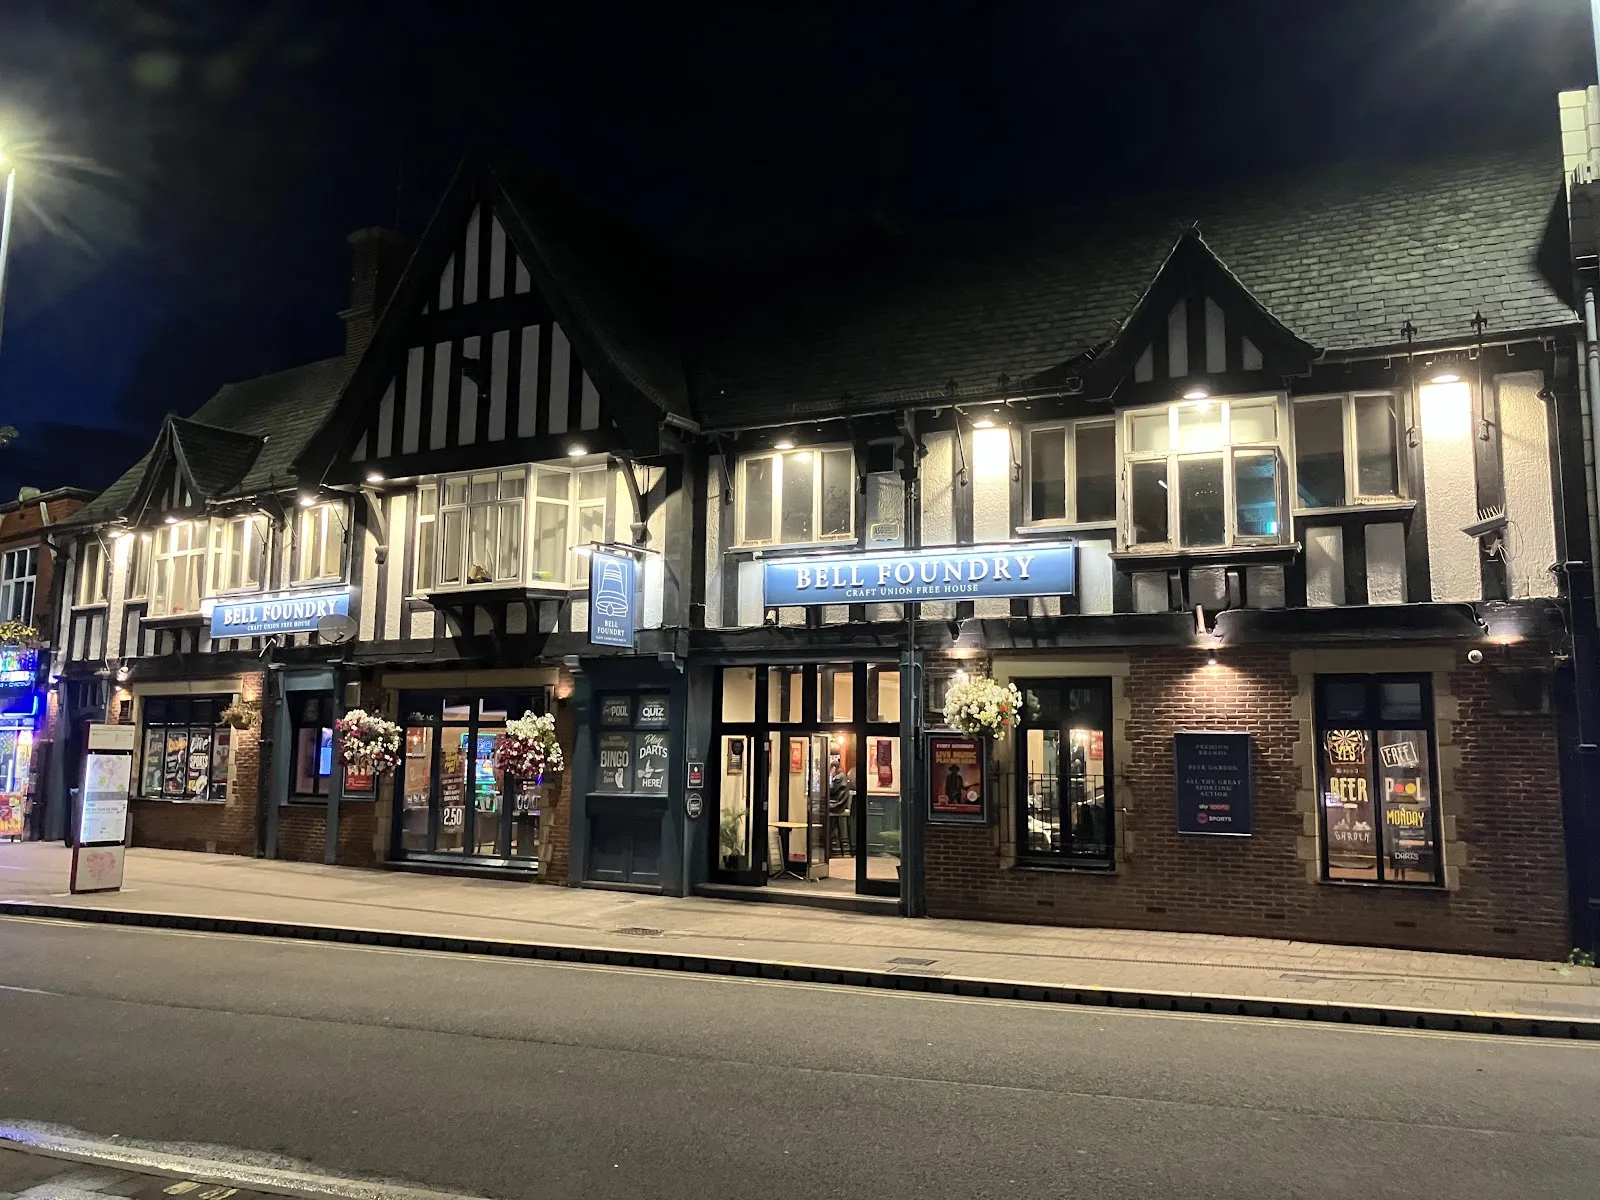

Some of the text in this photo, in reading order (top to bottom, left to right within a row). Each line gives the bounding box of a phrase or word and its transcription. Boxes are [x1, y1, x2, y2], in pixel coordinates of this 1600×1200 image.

[796, 554, 1035, 589] BELL FOUNDRY
[845, 583, 979, 598] CRAFT UNION FREE HOUSE
[223, 598, 338, 626] BELL FOUNDRY
[263, 622, 280, 631] UNION
[281, 621, 293, 629] FREE
[604, 619, 619, 628] BELL
[597, 626, 625, 637] FOUNDRY
[611, 705, 628, 717] POOL
[642, 707, 664, 718] QUIZ
[644, 733, 664, 748] Play
[600, 750, 629, 768] BINGO
[639, 745, 668, 759] DARTS
[1384, 746, 1412, 764] FREE
[642, 776, 664, 788] HERE!
[1330, 777, 1369, 802] BEER
[1384, 777, 1426, 801] POOL
[443, 807, 463, 826] 2.50
[1386, 808, 1425, 828] MONDAY
[1334, 831, 1371, 843] GARDEN
[1394, 852, 1420, 861] DARTS
